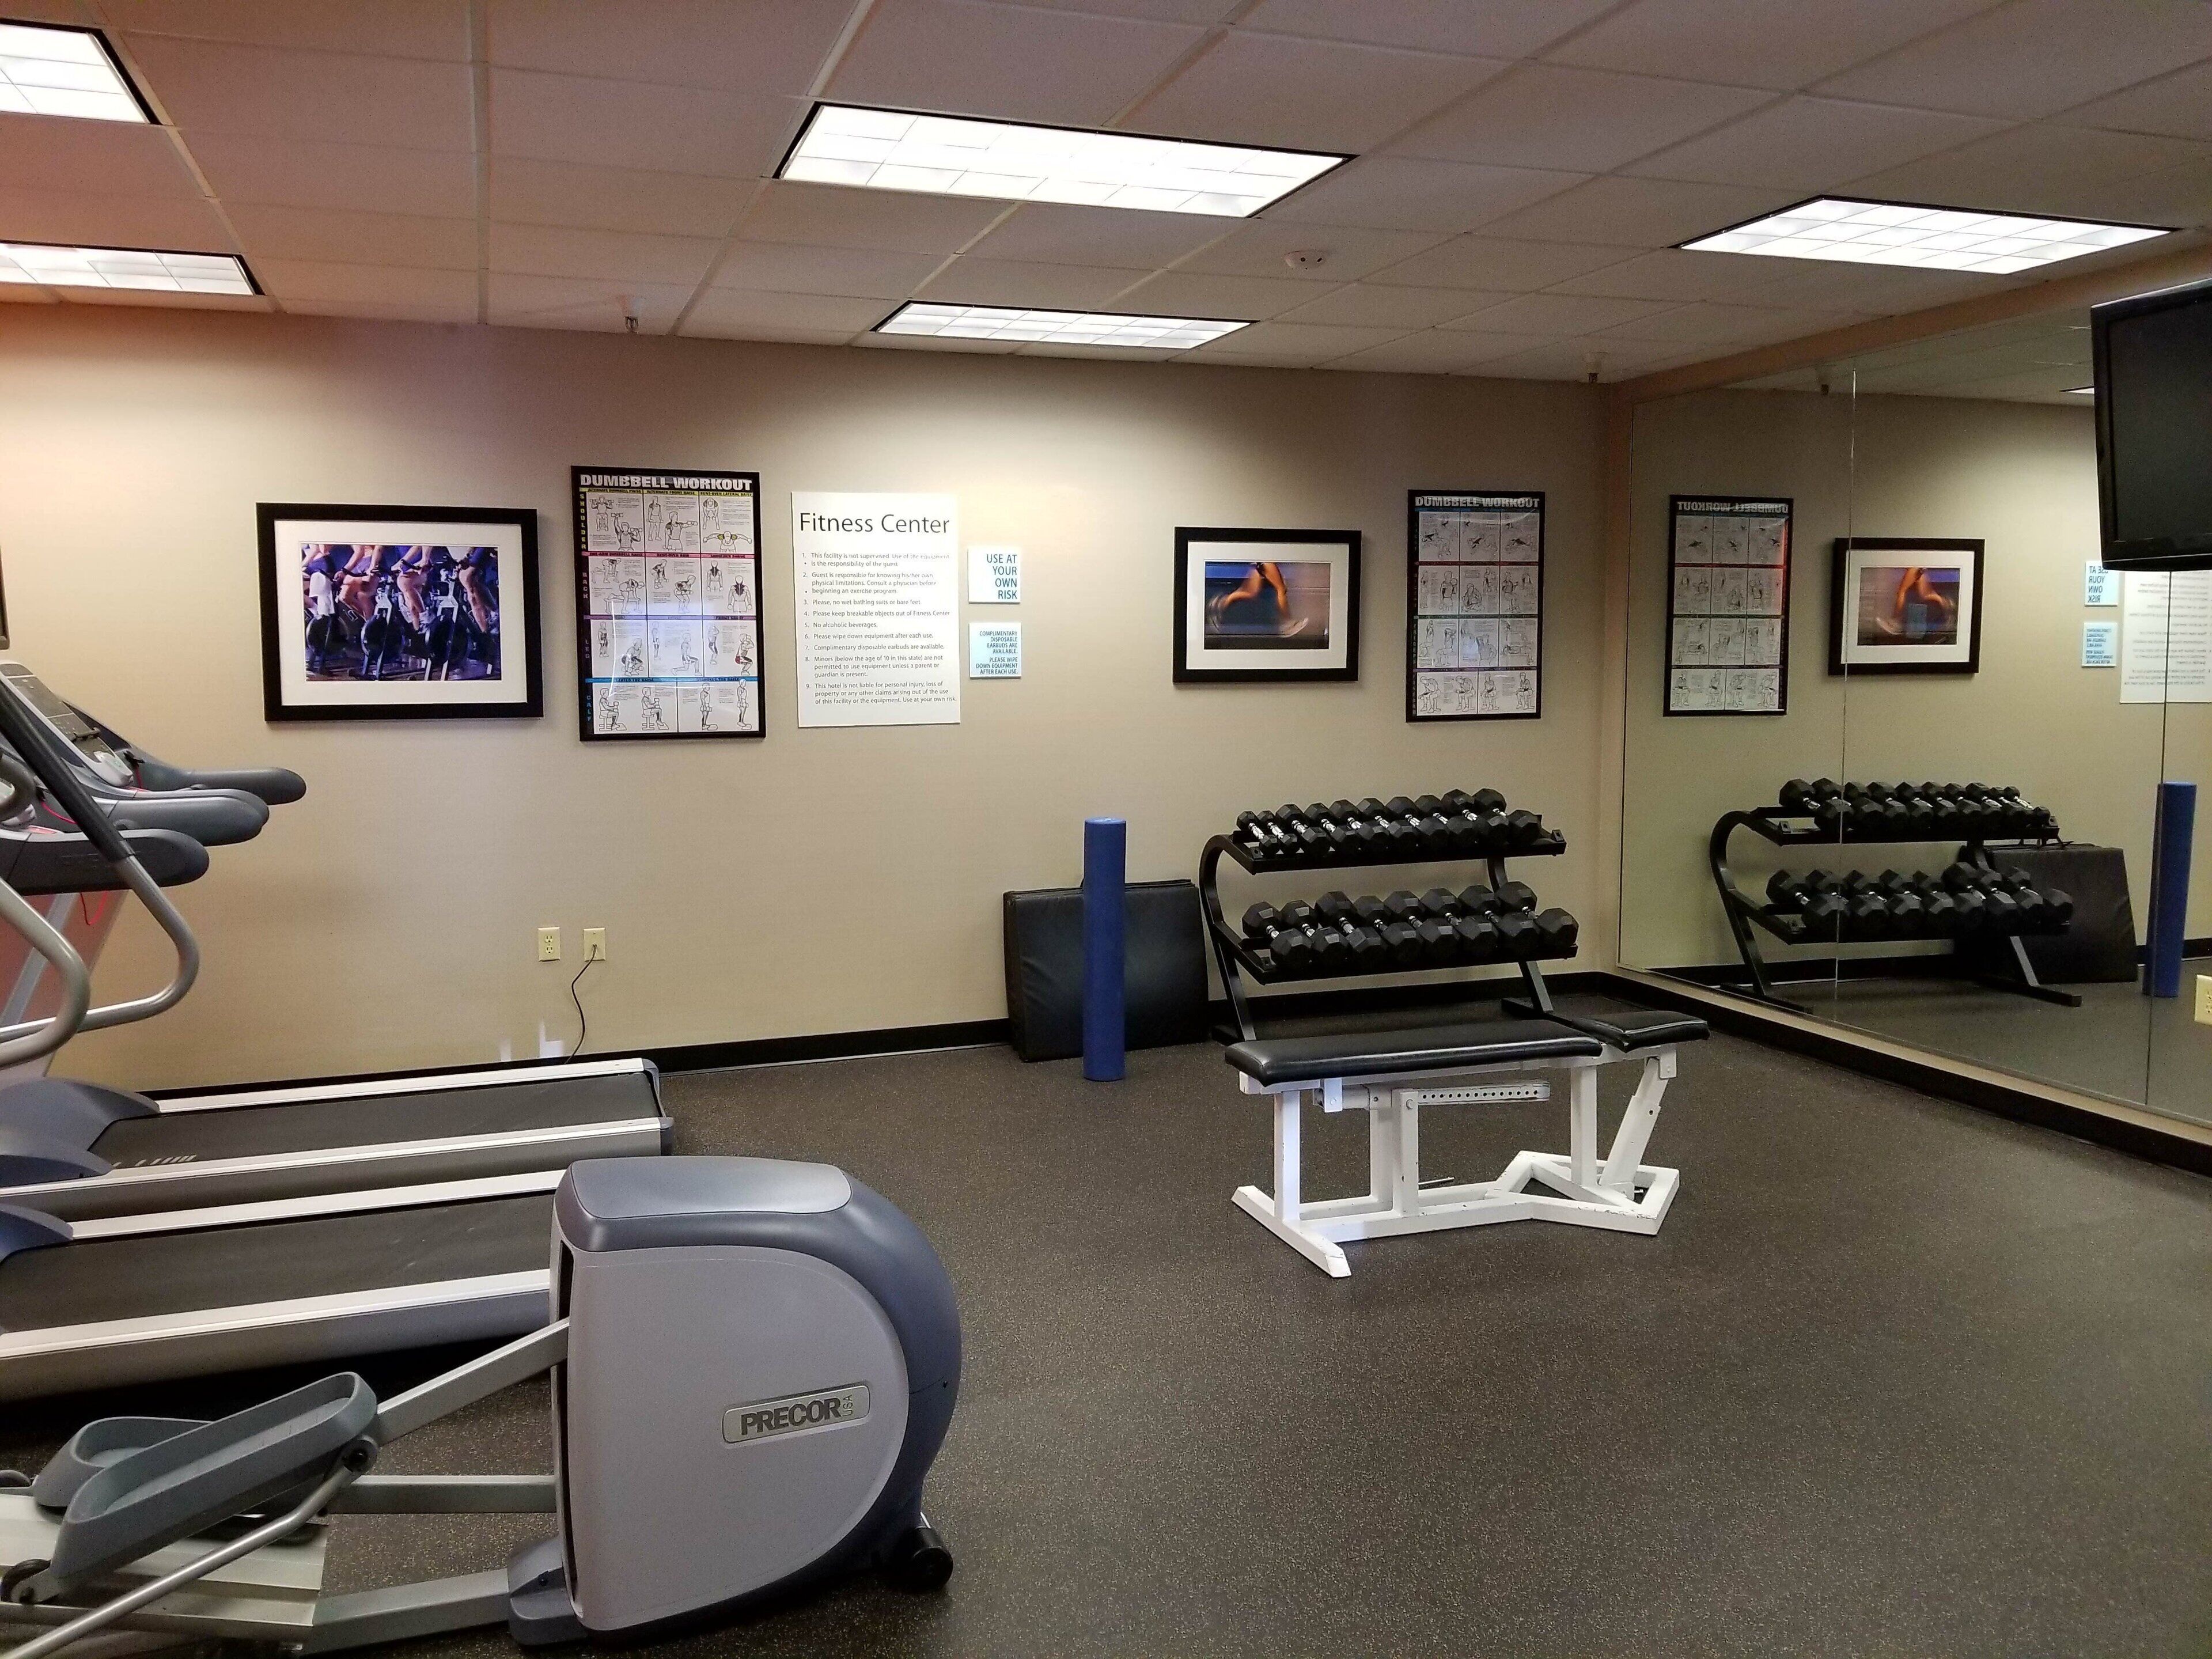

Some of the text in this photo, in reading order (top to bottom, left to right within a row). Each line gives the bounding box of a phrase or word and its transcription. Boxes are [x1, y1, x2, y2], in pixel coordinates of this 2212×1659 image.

[580, 474, 752, 491] DUMBBELL WORKOUT
[1415, 496, 1540, 507] DUMBBELL WORKOUT
[800, 513, 950, 533] Fitness Center
[987, 554, 1017, 563] USE AT
[993, 566, 1017, 575] YOUR
[995, 578, 1017, 588] OWN
[998, 590, 1017, 599] RISK
[842, 1394, 853, 1417] USA
[741, 1397, 842, 1435] PRECOR
